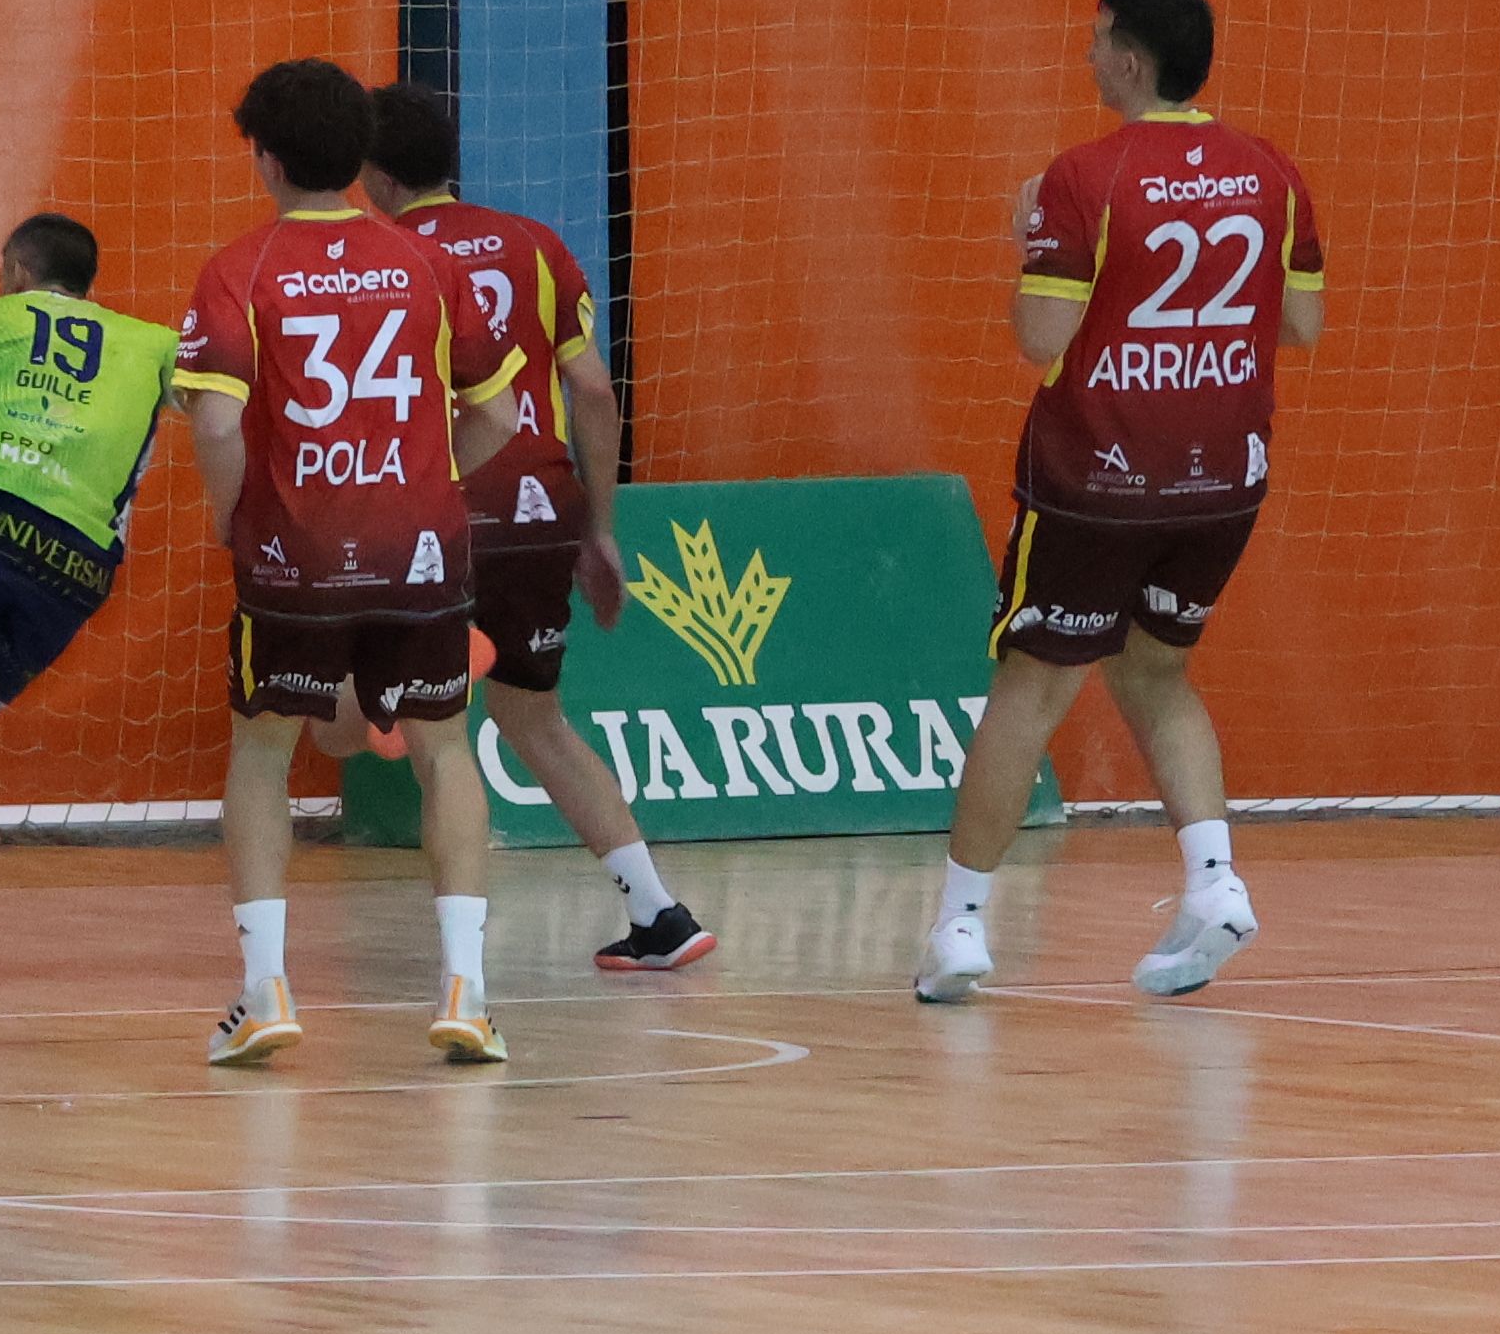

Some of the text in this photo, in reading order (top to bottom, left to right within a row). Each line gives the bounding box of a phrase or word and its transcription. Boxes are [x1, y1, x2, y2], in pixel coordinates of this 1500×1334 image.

[1168, 174, 1260, 203] cabero
[440, 234, 504, 257] ero
[307, 267, 410, 295] cabero
[1127, 214, 1264, 328] 22
[25, 304, 104, 383] 19
[281, 308, 423, 429] 34
[16, 369, 93, 405] GUILLE
[295, 437, 407, 488] POLA
[269, 671, 344, 698] Zanfon
